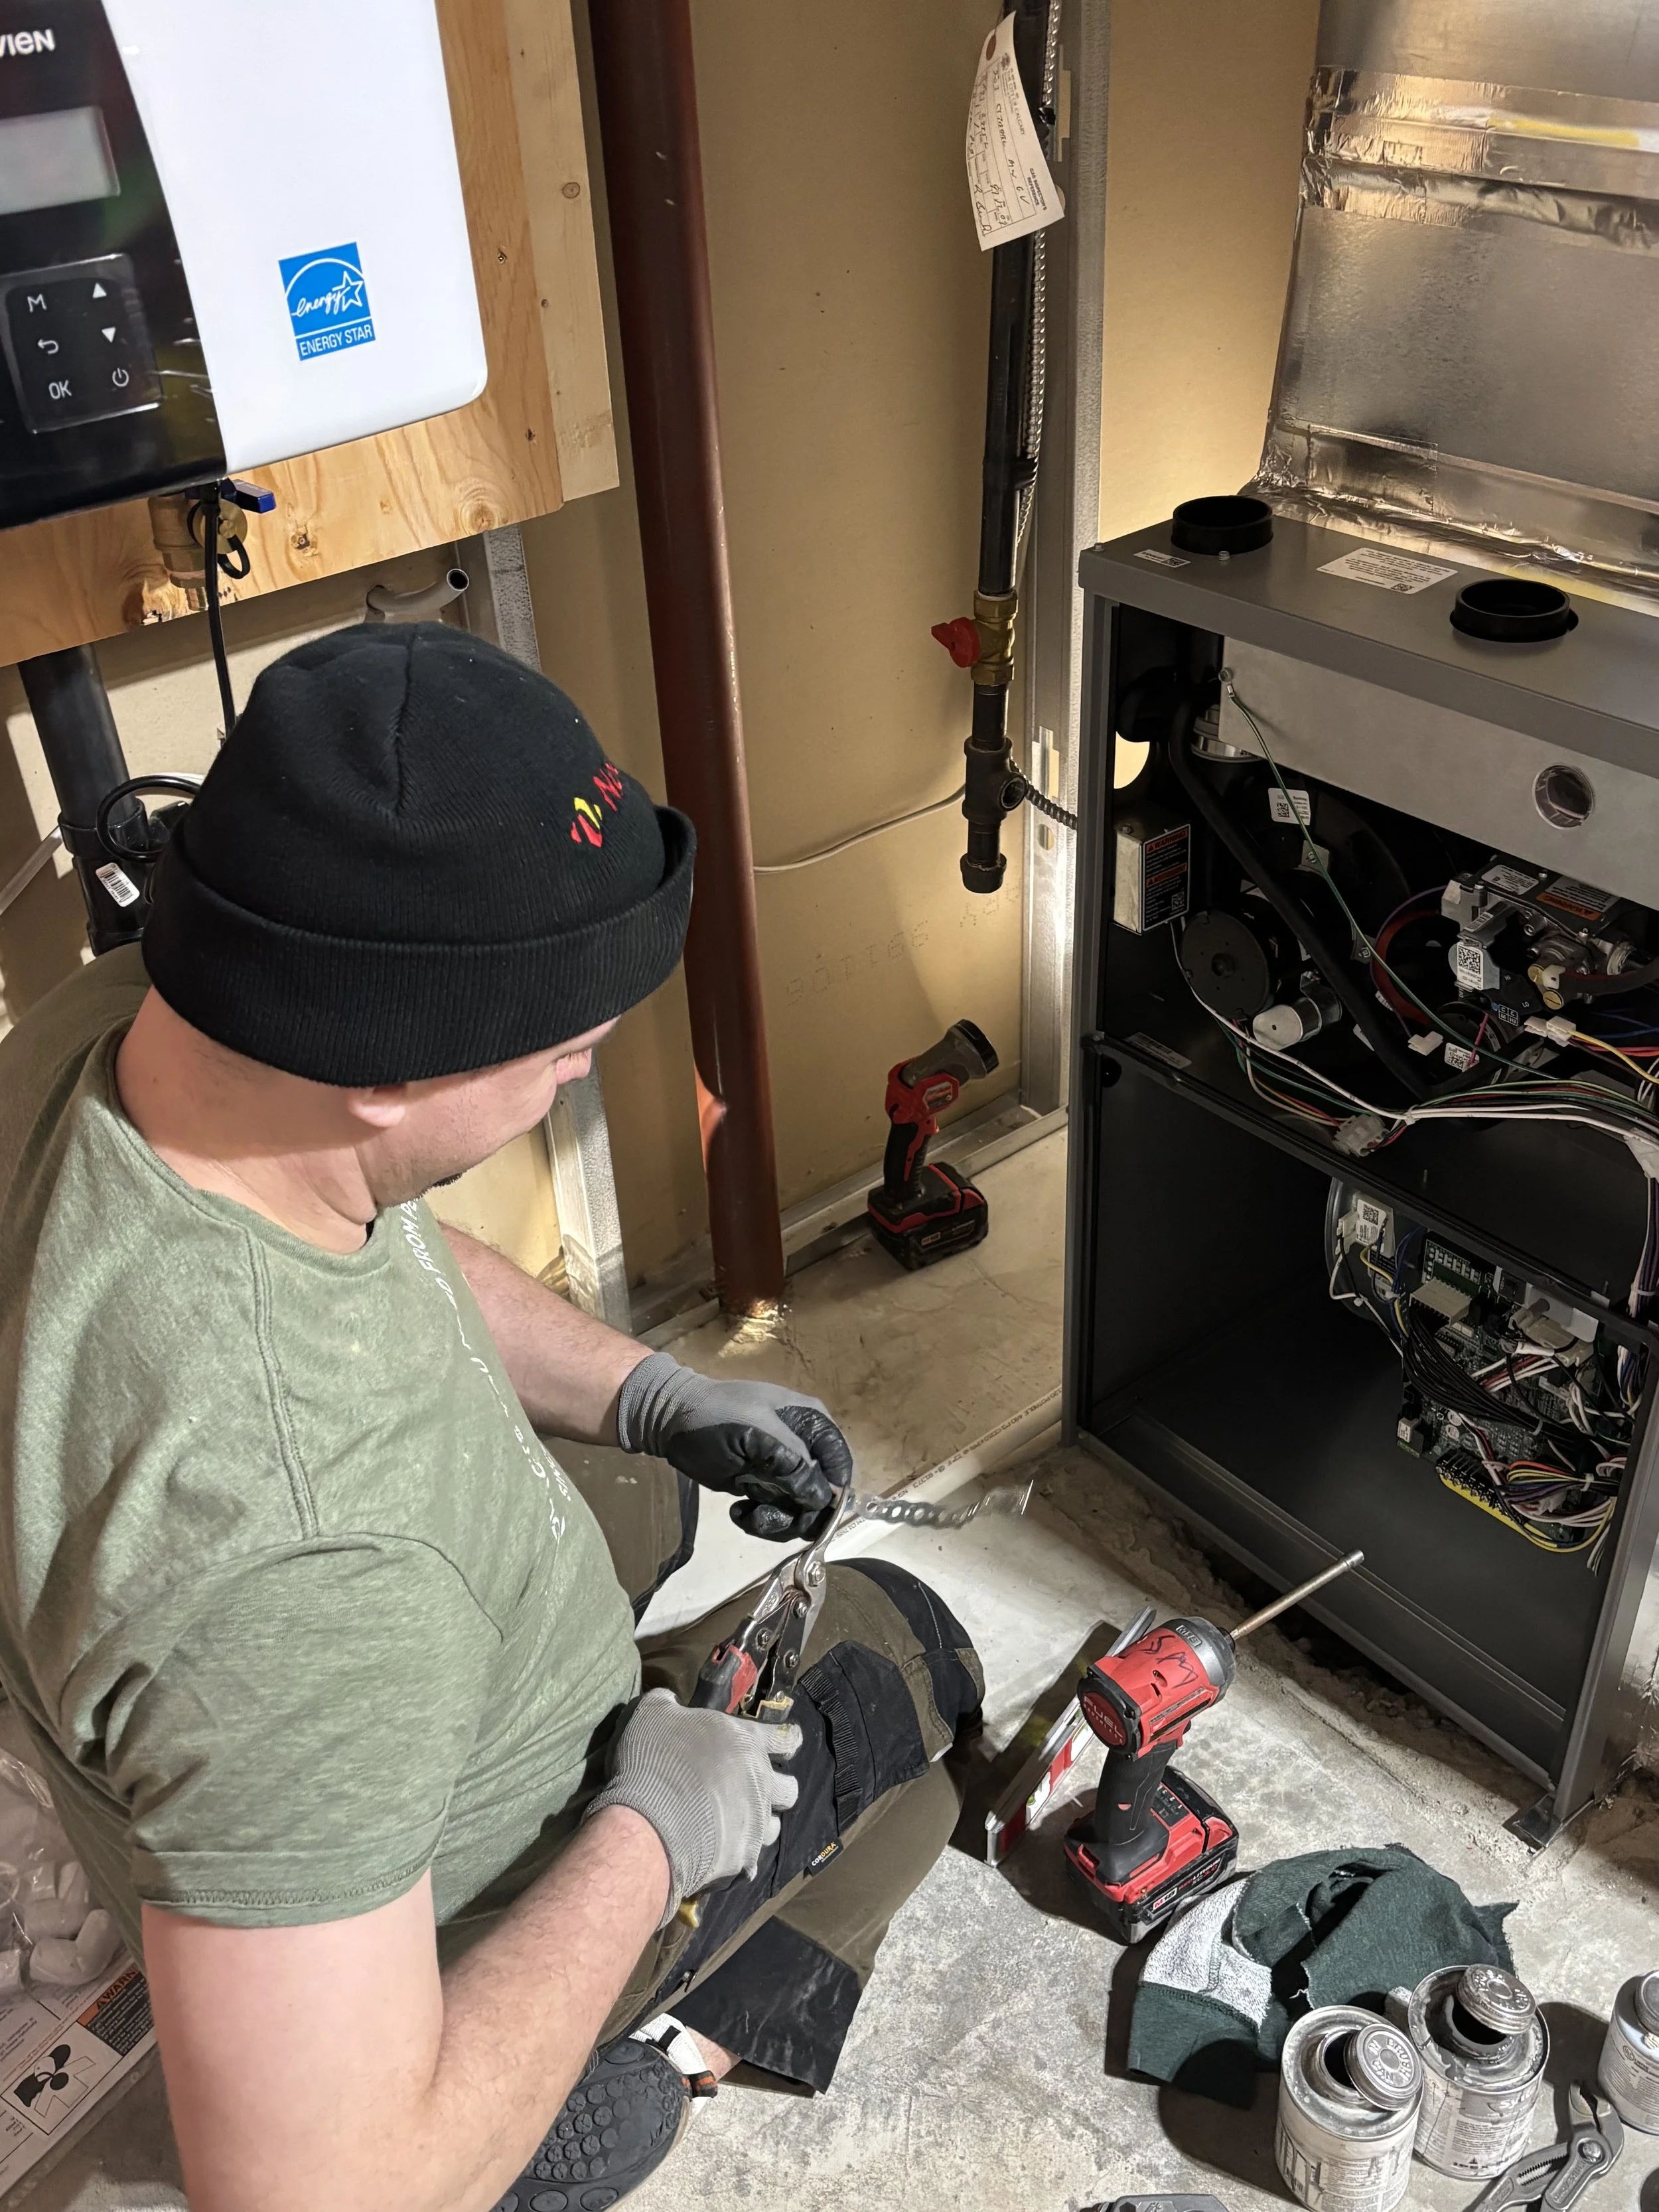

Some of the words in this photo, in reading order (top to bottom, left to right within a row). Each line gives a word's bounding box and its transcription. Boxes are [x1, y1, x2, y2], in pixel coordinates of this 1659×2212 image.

[1015, 108, 1025, 135] CALGARY
[27, 293, 47, 313] M
[299, 332, 343, 356] ENERGY
[344, 324, 372, 344] STAR
[48, 380, 72, 400] OK
[400, 1216, 441, 1274] FROM
[1083, 1695, 1122, 1738] FUEL
[811, 1842, 836, 1866] CORDURA
[1177, 1857, 1220, 1890] REDLITHIUM
[1153, 1890, 1174, 1908] M18
